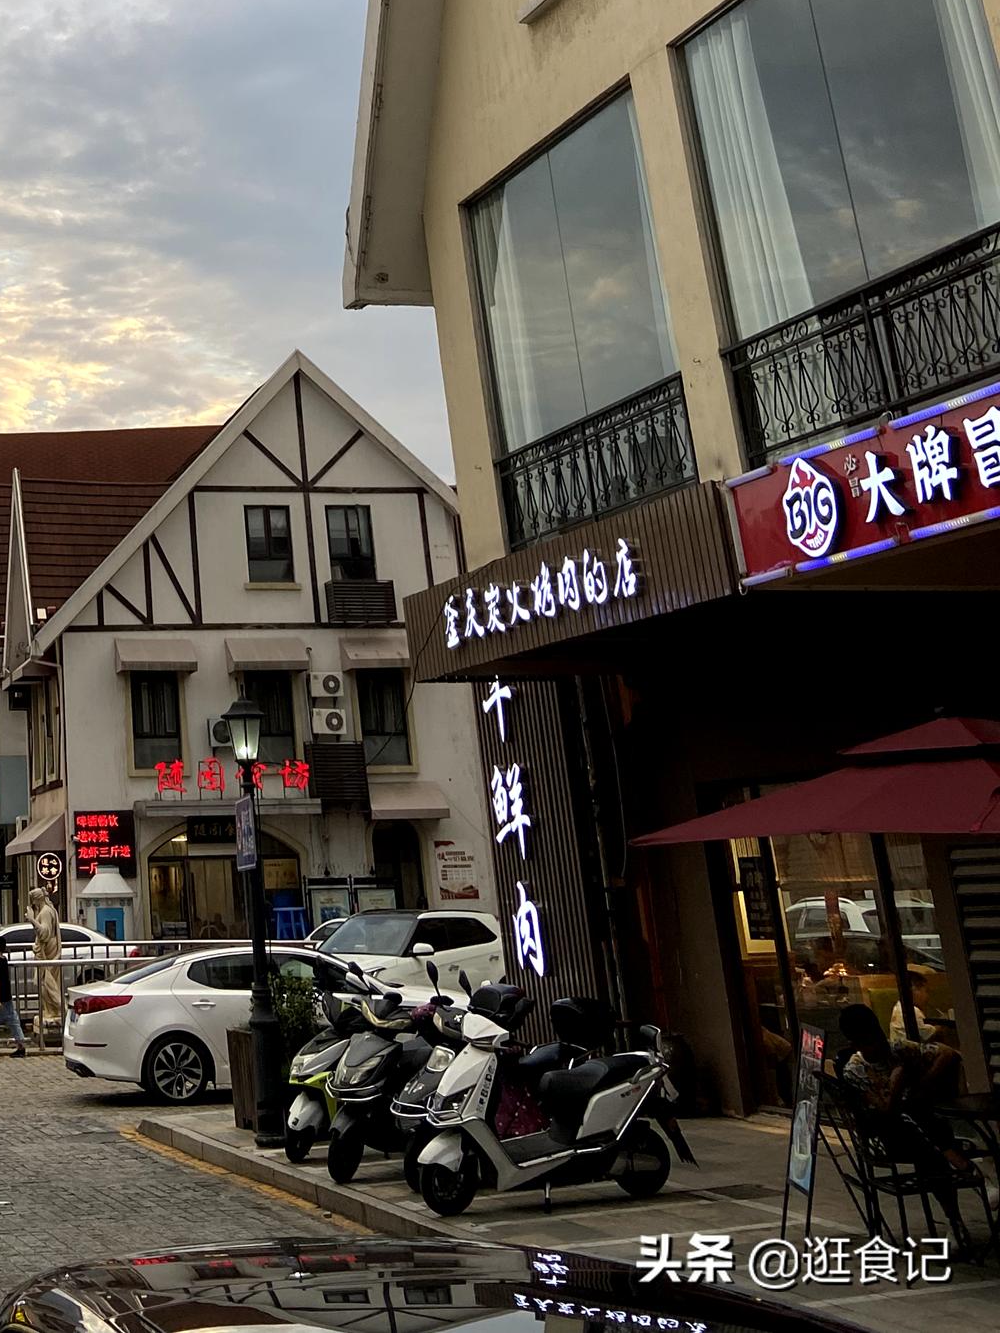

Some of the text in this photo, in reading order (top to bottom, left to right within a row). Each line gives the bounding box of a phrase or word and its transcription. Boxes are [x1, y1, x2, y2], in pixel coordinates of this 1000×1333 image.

[785, 480, 834, 540] BIG
[76, 814, 119, 828] 啤酒畅饮
[78, 845, 131, 859] 龙虾三斤送
